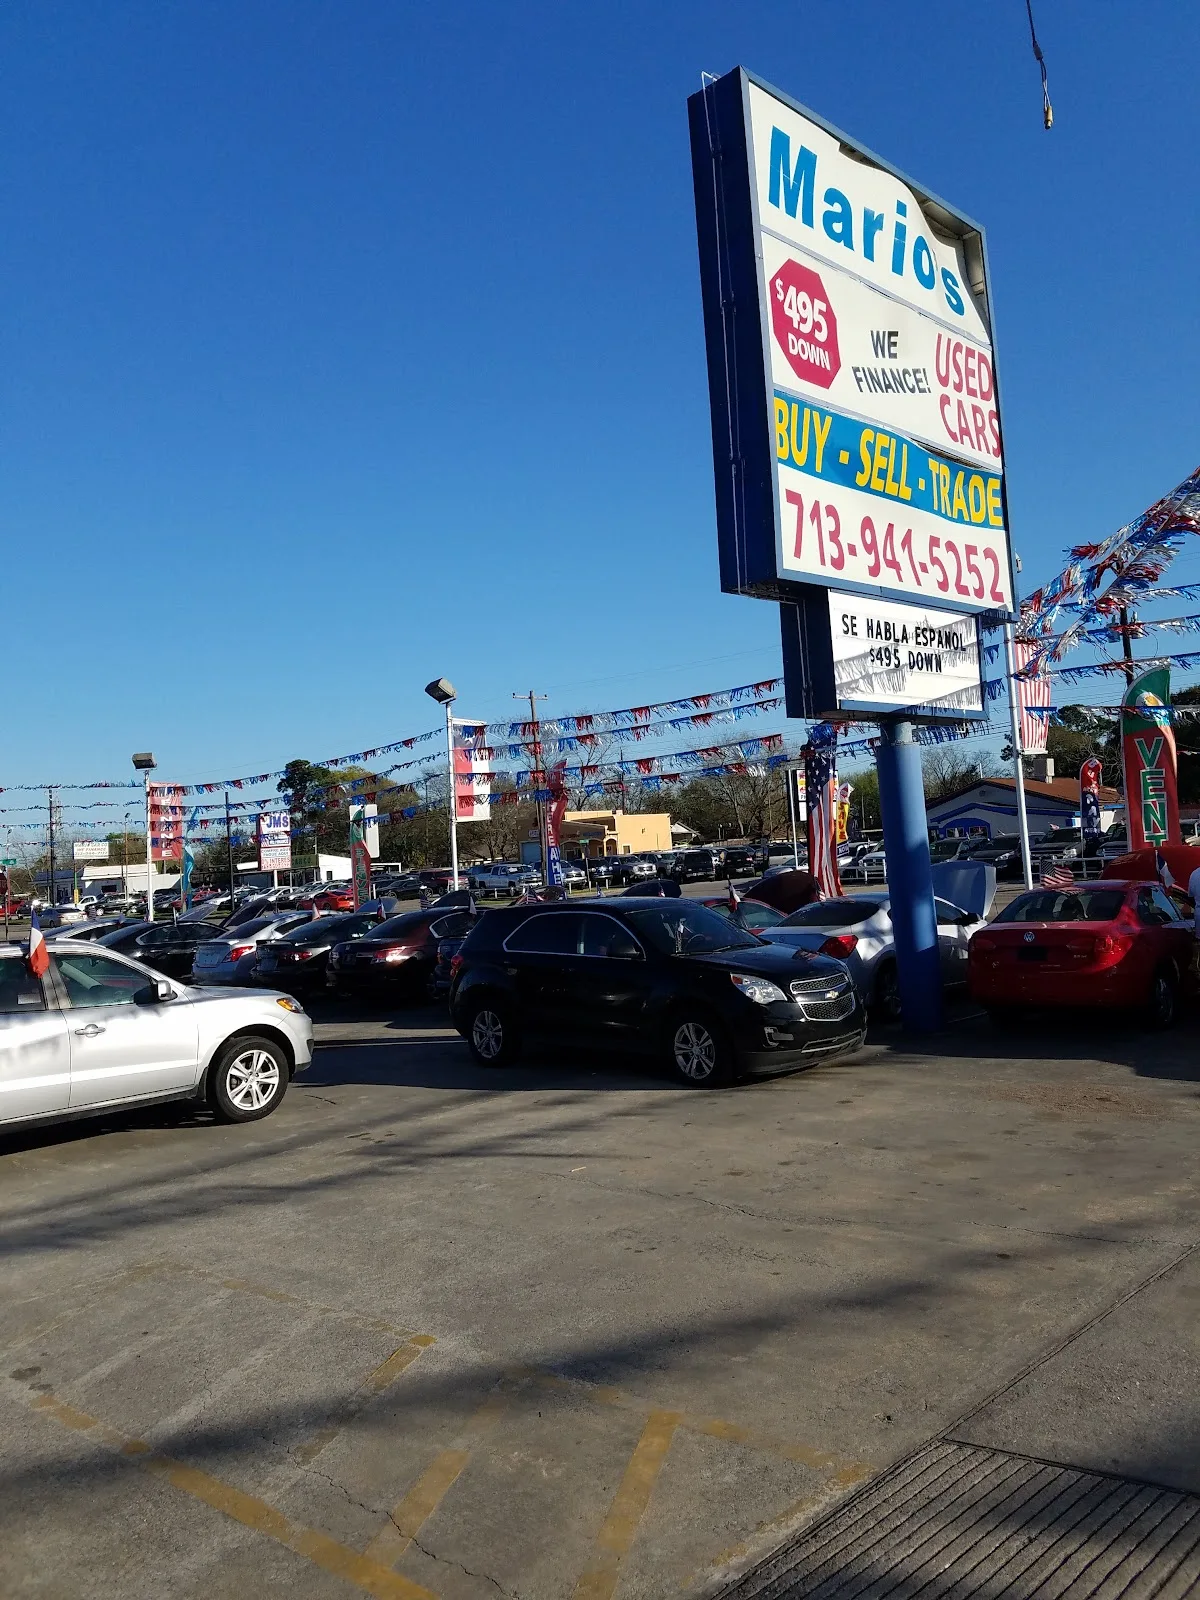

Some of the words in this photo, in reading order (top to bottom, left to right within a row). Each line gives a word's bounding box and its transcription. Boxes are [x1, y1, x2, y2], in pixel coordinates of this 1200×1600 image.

[775, 278, 828, 342] $495
[788, 333, 831, 371] DOWN
[870, 330, 899, 359] WE
[852, 366, 932, 394] FINANCE!
[935, 333, 993, 402] USED
[940, 393, 1000, 458] CARS
[774, 396, 832, 473] BUY
[855, 428, 912, 500] SELL
[929, 458, 1003, 526] TRADE
[785, 488, 1005, 603] 713-941-5252
[842, 613, 858, 636] SE
[867, 618, 909, 644] HABLA
[915, 626, 967, 651] ESPANOL
[870, 647, 900, 668] $495
[908, 650, 942, 673] DOWN
[267, 816, 289, 828] JMS
